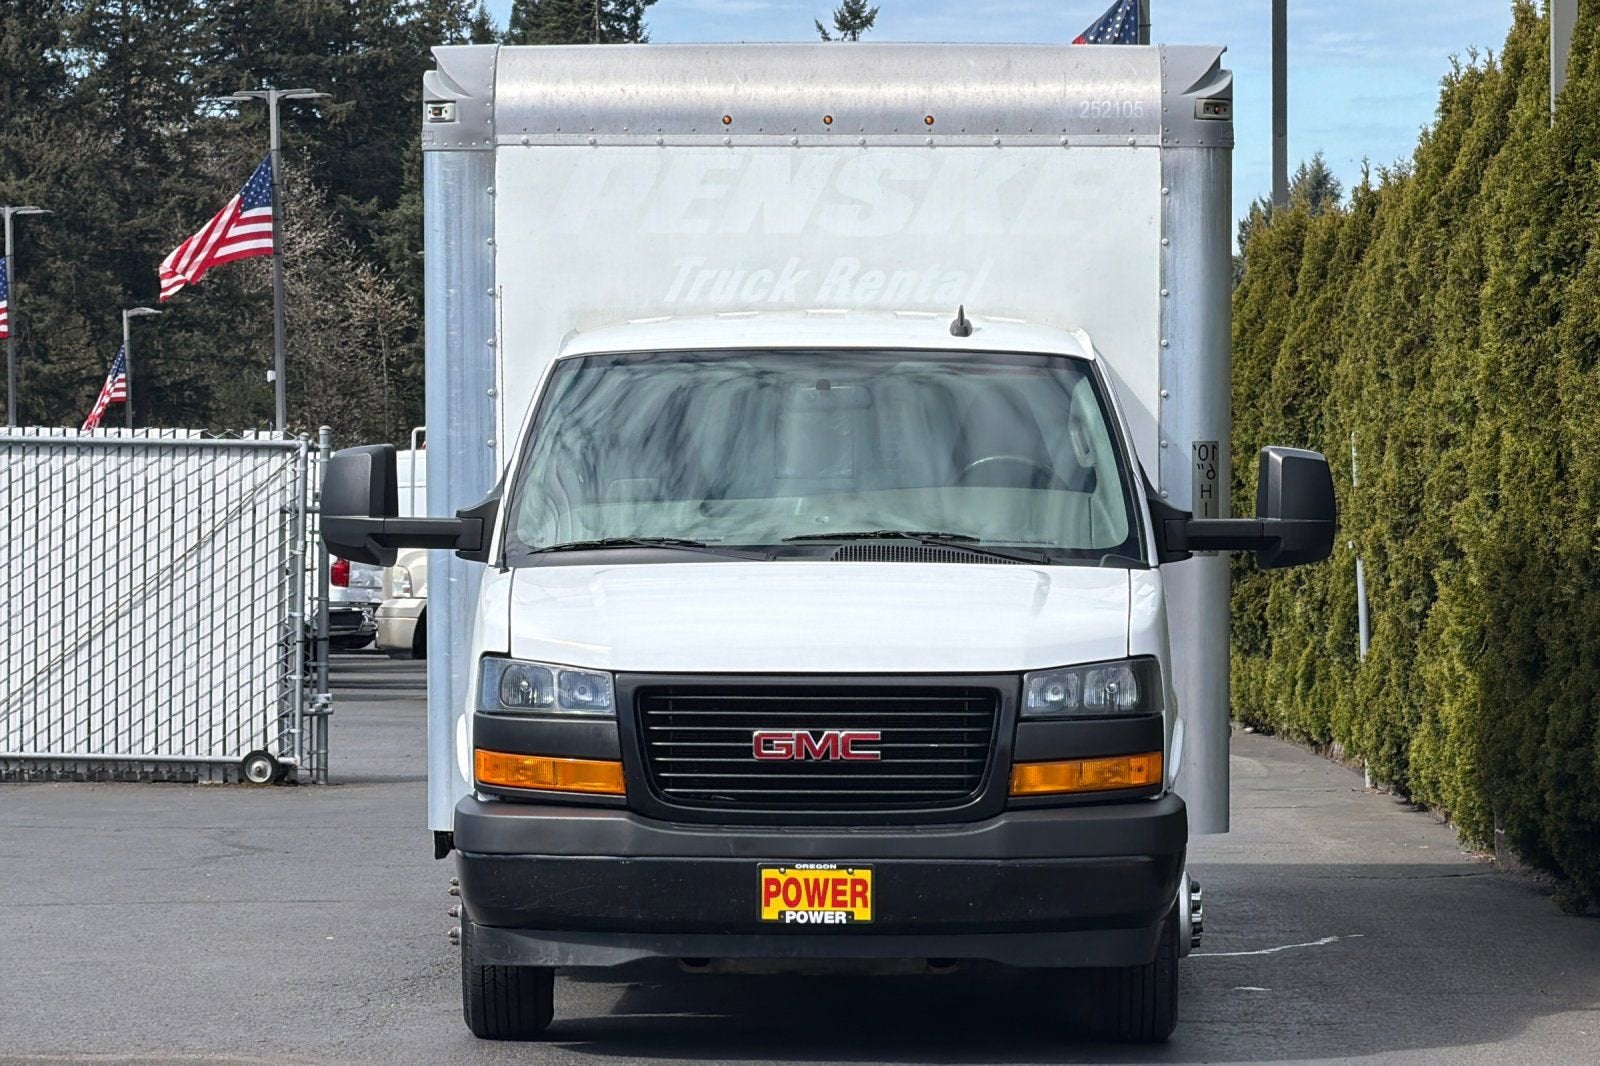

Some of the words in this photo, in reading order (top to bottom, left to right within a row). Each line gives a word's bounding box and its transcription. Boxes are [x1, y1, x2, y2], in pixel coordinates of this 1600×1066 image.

[1079, 101, 1144, 119] 252105
[546, 152, 1110, 238] PENSKE
[666, 258, 809, 304] Truck
[815, 256, 992, 304] Rental
[753, 730, 881, 760] GMC
[763, 877, 869, 908] POWER
[785, 911, 847, 924] POWER
